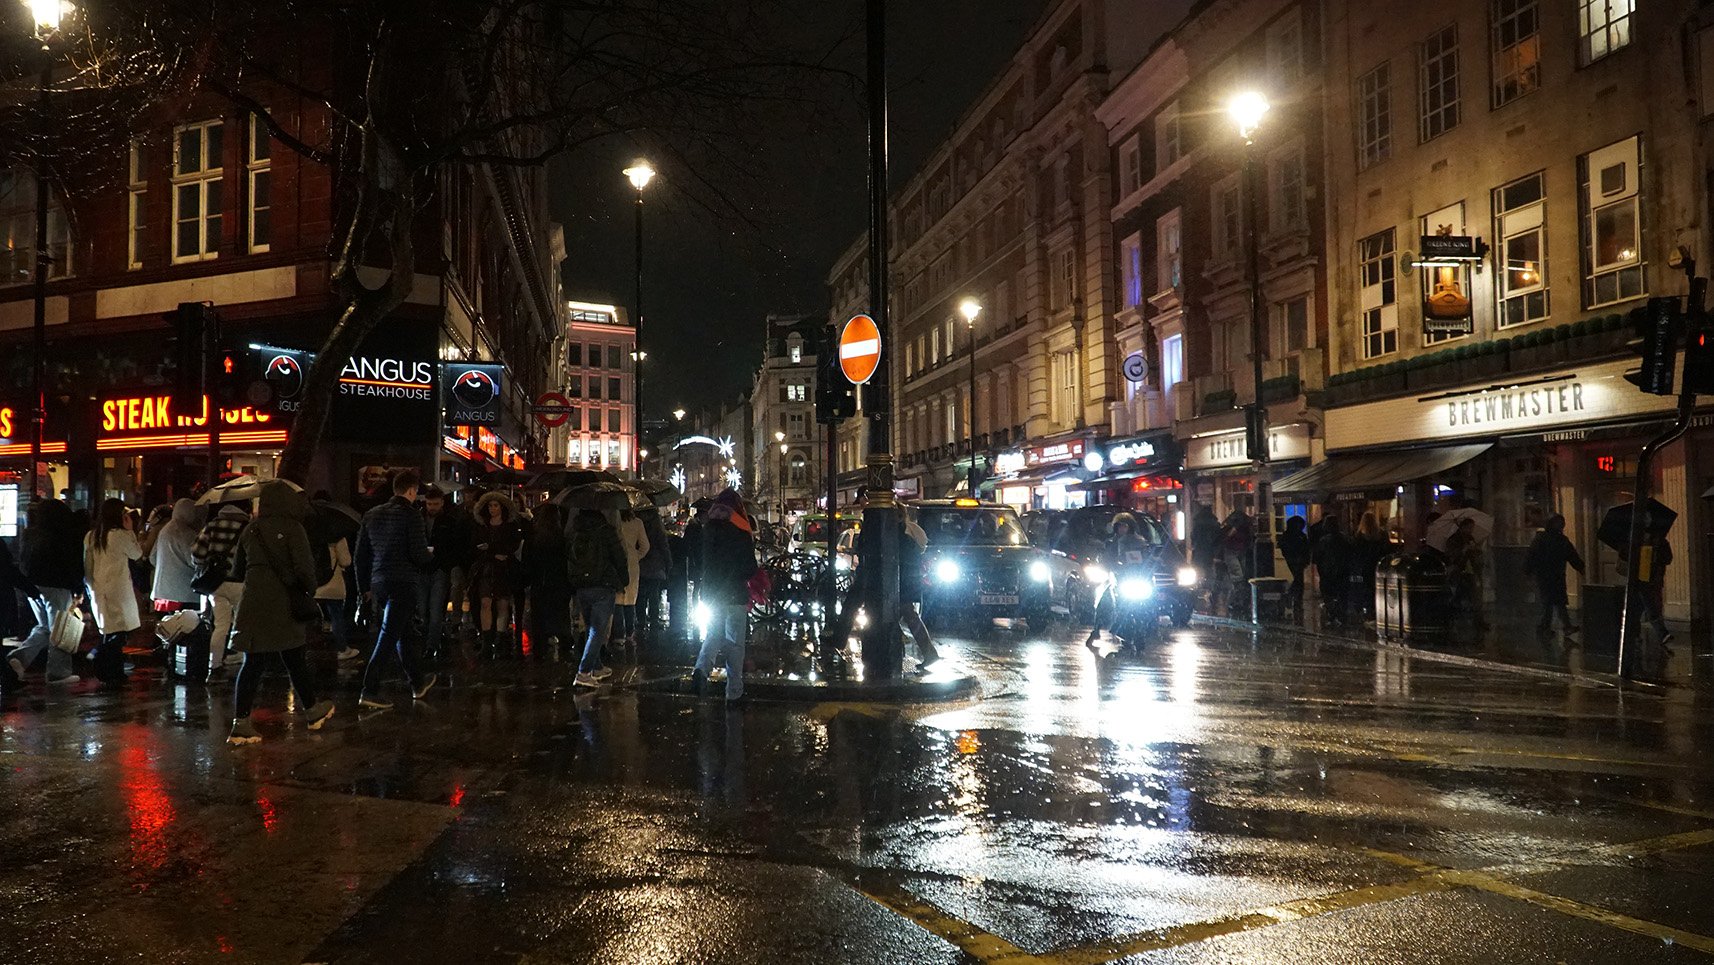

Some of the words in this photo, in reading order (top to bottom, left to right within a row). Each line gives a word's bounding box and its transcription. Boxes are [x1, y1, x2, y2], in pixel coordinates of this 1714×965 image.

[340, 356, 432, 384] ANGUS
[339, 383, 431, 401] STEAKHOUSE
[103, 396, 172, 431] STEAK
[1448, 382, 1584, 426] BREWMASTER
[453, 411, 495, 421] ANGUS
[1543, 430, 1585, 442] BREWMASTER
